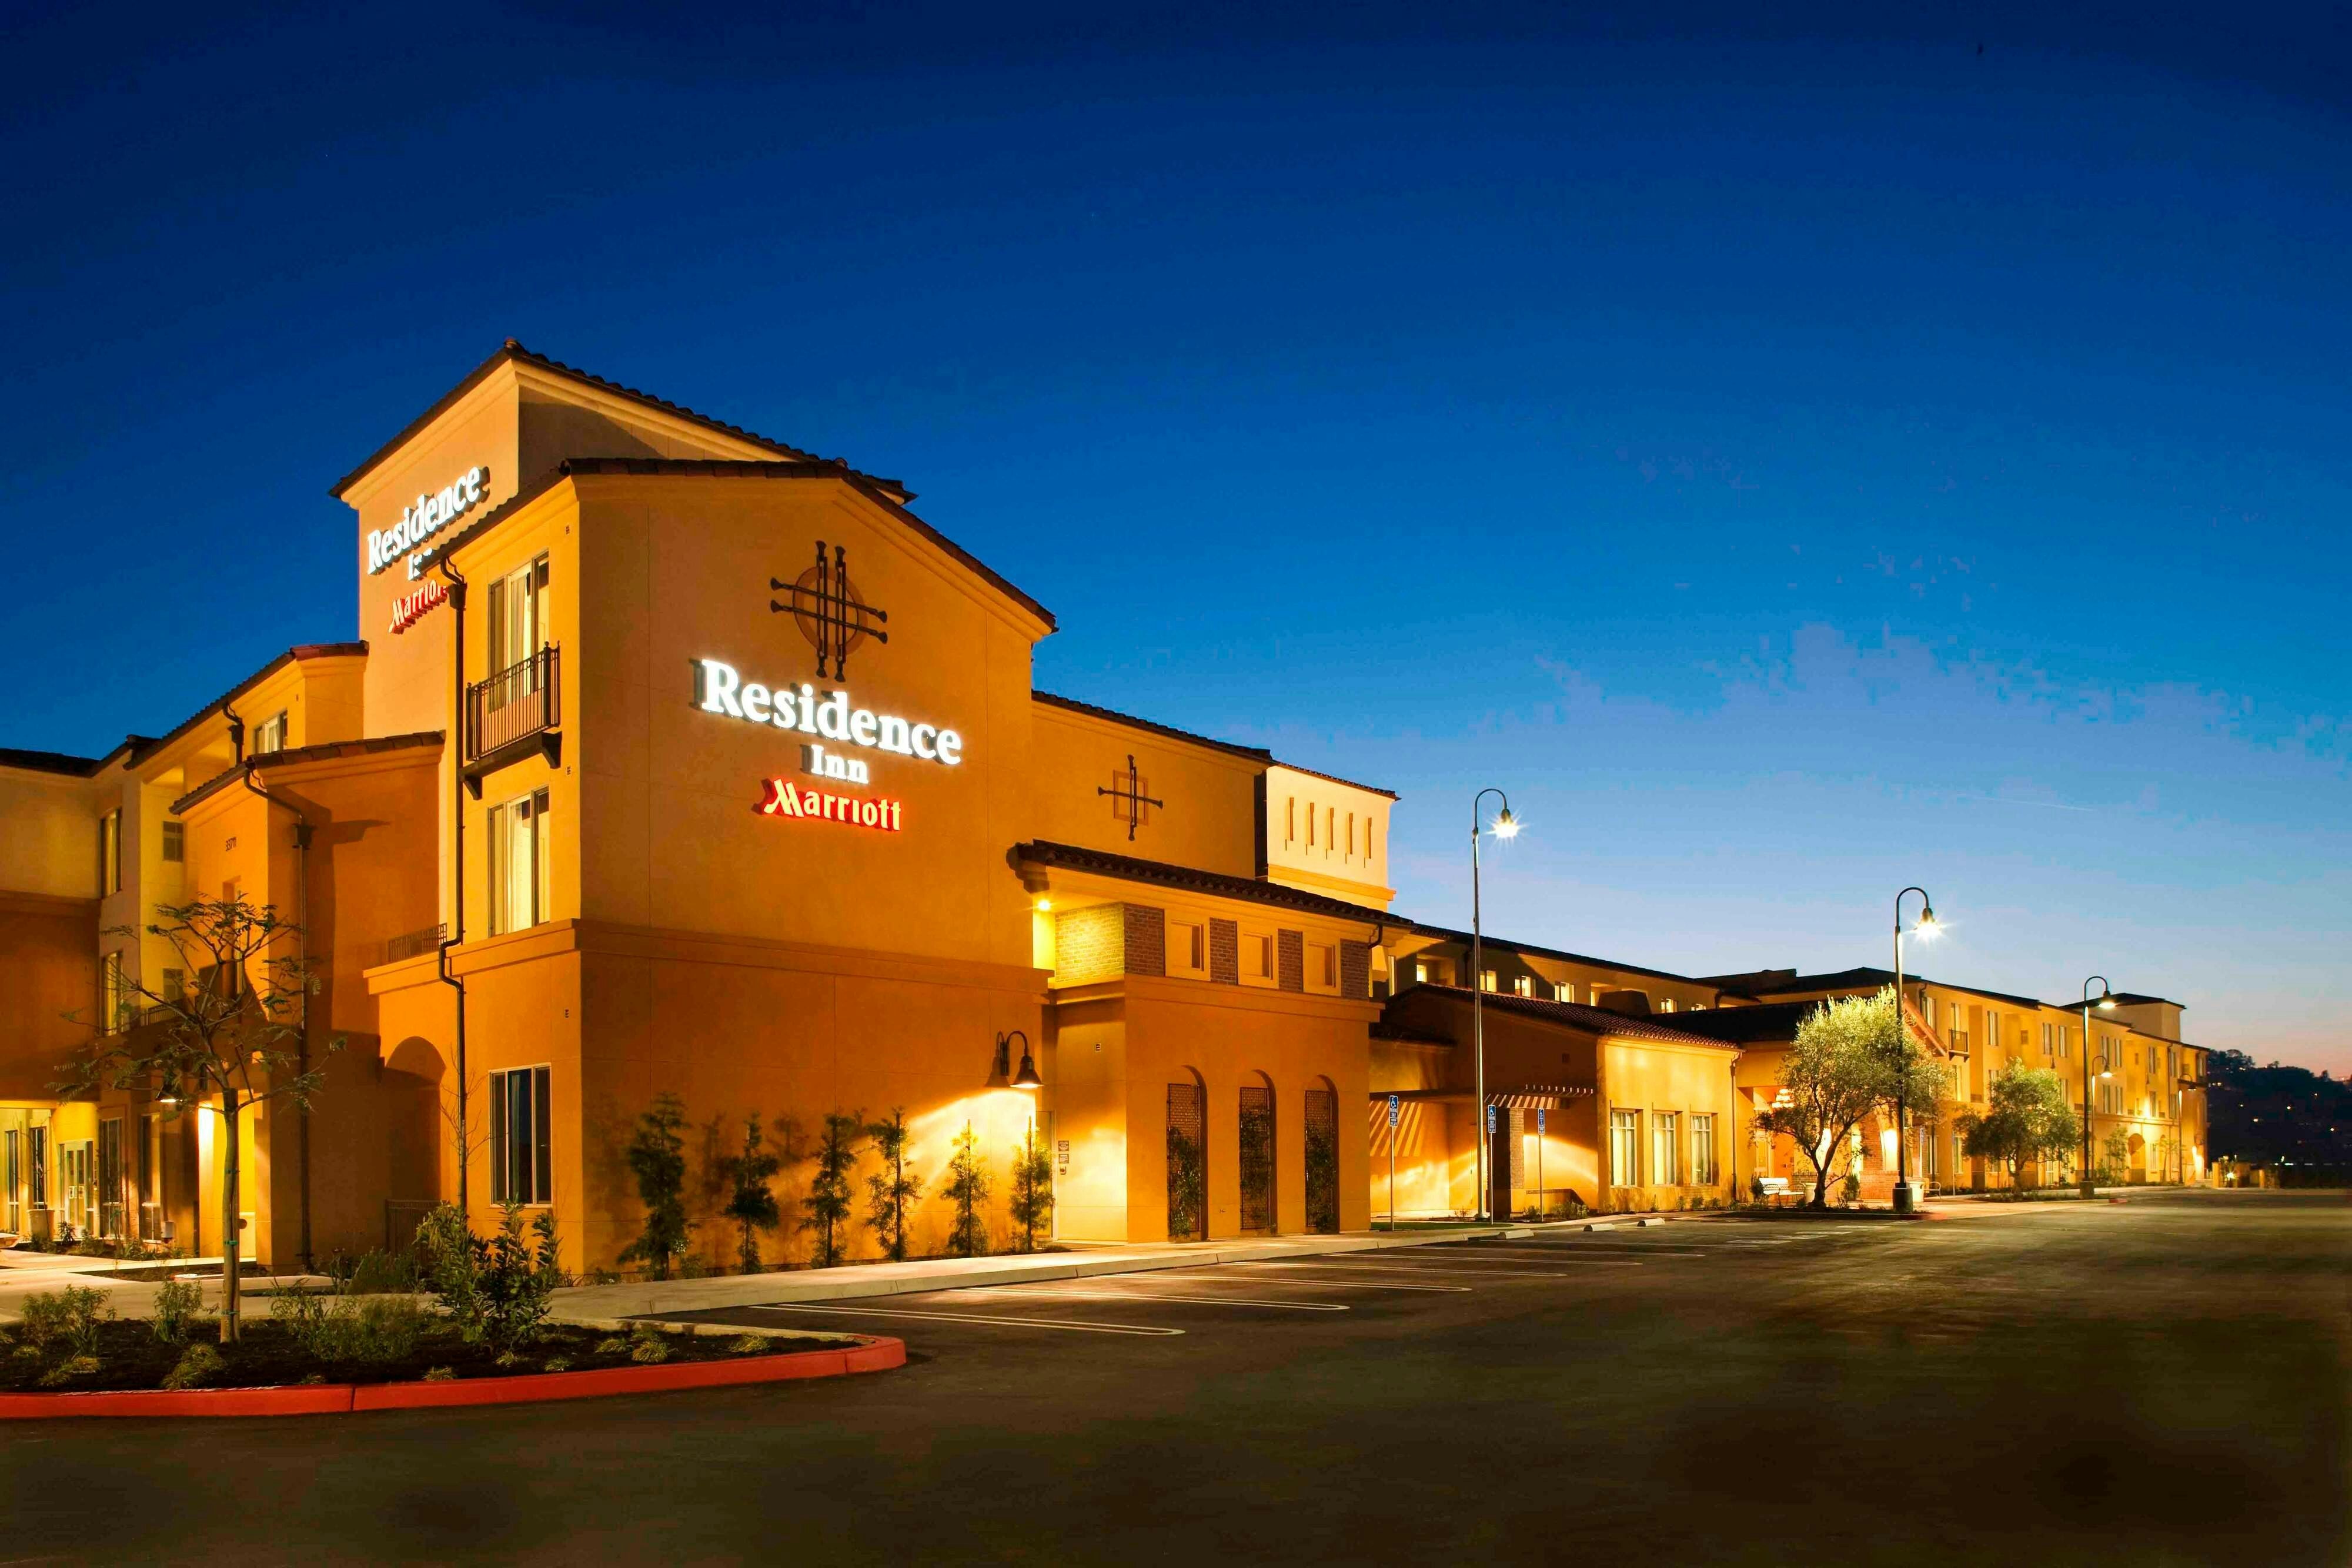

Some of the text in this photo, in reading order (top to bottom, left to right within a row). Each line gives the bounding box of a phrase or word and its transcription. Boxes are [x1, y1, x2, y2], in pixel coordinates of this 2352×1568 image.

[367, 466, 482, 575] Residence
[701, 658, 961, 765] Residence
[811, 744, 869, 784] Inn
[764, 778, 901, 831] Marriott
